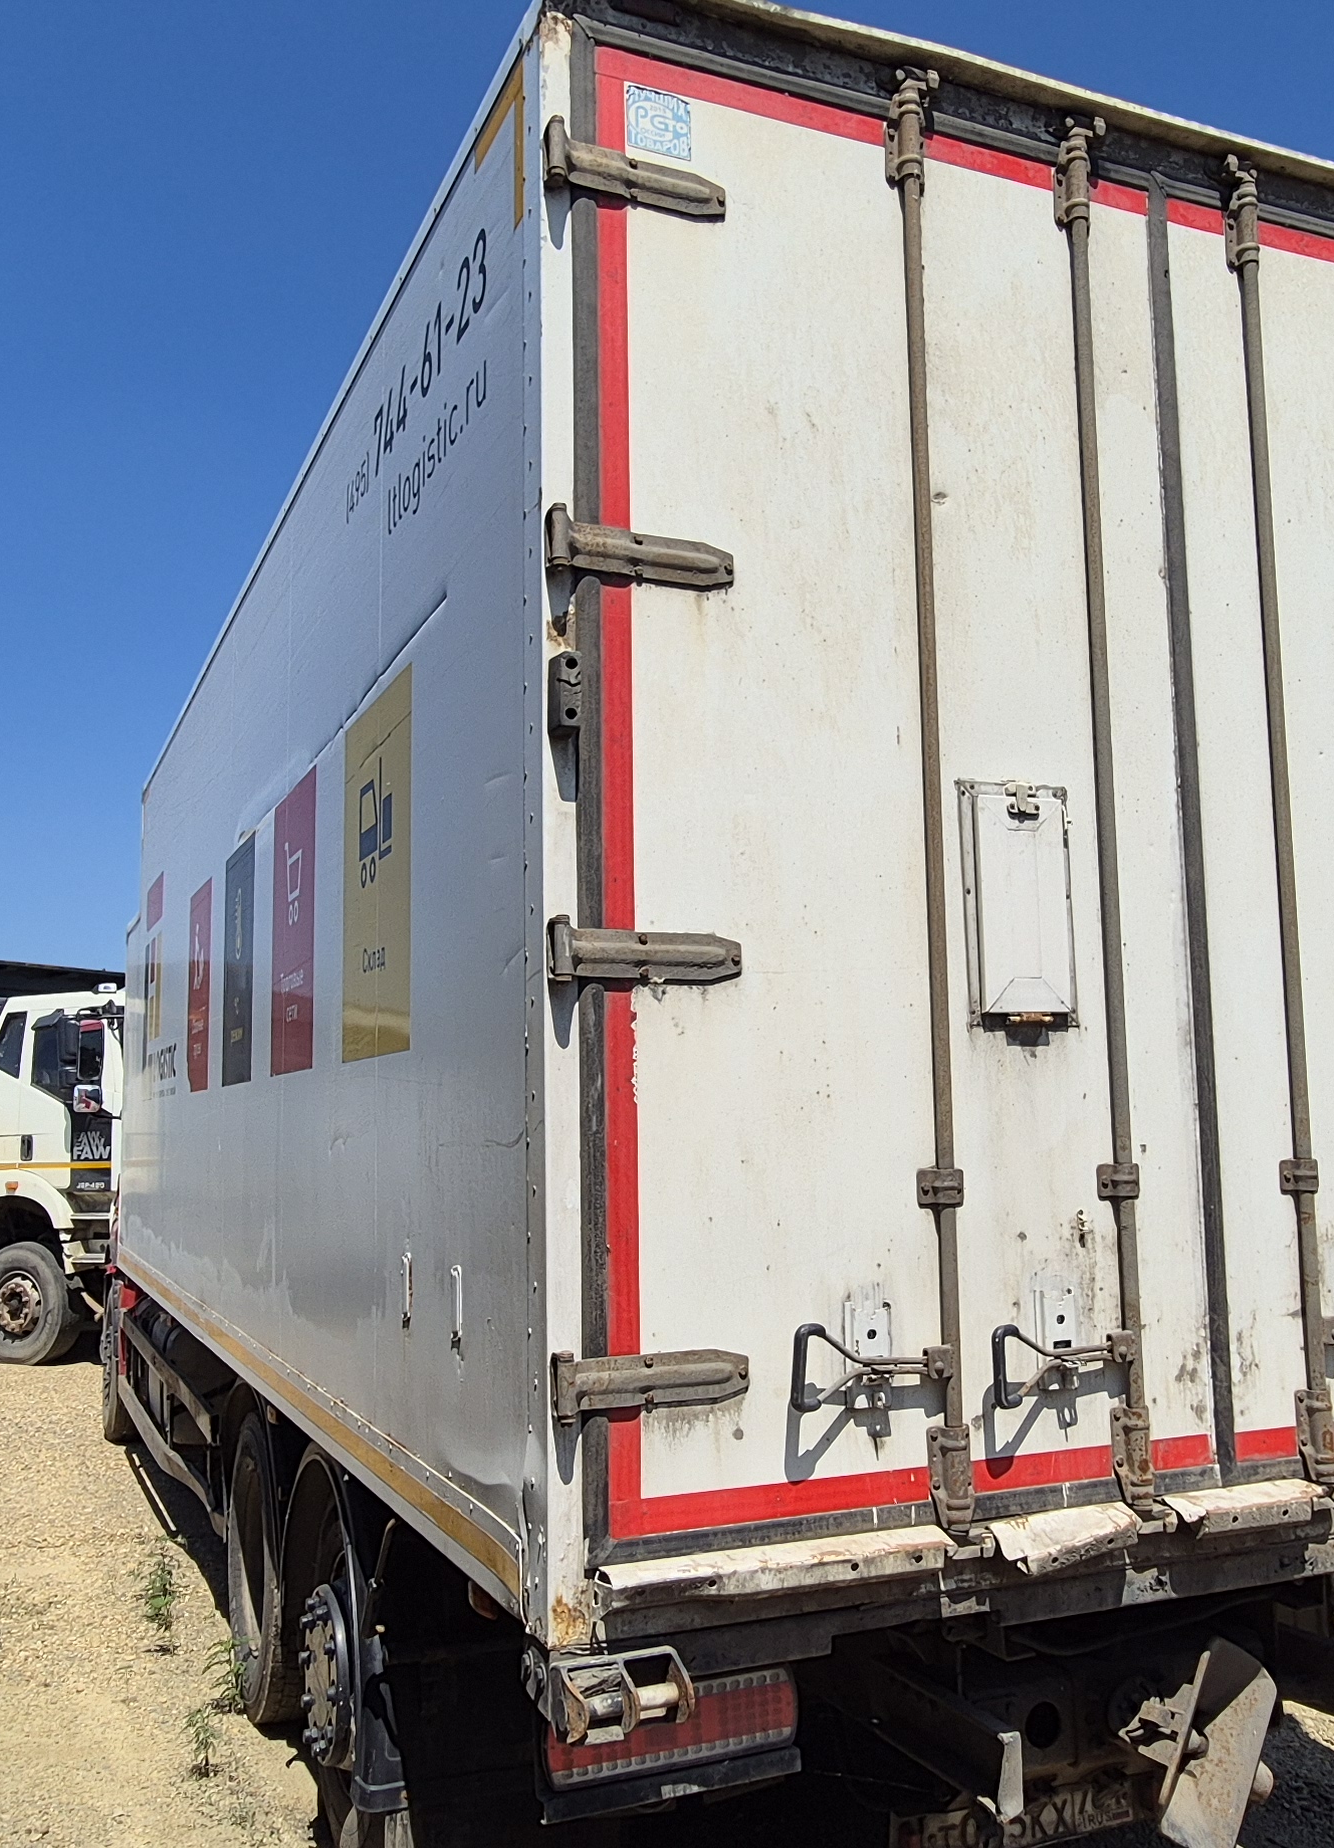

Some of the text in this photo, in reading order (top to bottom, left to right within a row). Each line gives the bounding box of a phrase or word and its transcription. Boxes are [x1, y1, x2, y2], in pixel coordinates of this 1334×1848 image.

[629, 125, 688, 156] ТОВАРОВ
[346, 228, 487, 525] (495) 744-61-23
[387, 359, 487, 536] ltlogistic.ru
[362, 947, 386, 974] Склад
[73, 1145, 111, 1160] FAW
